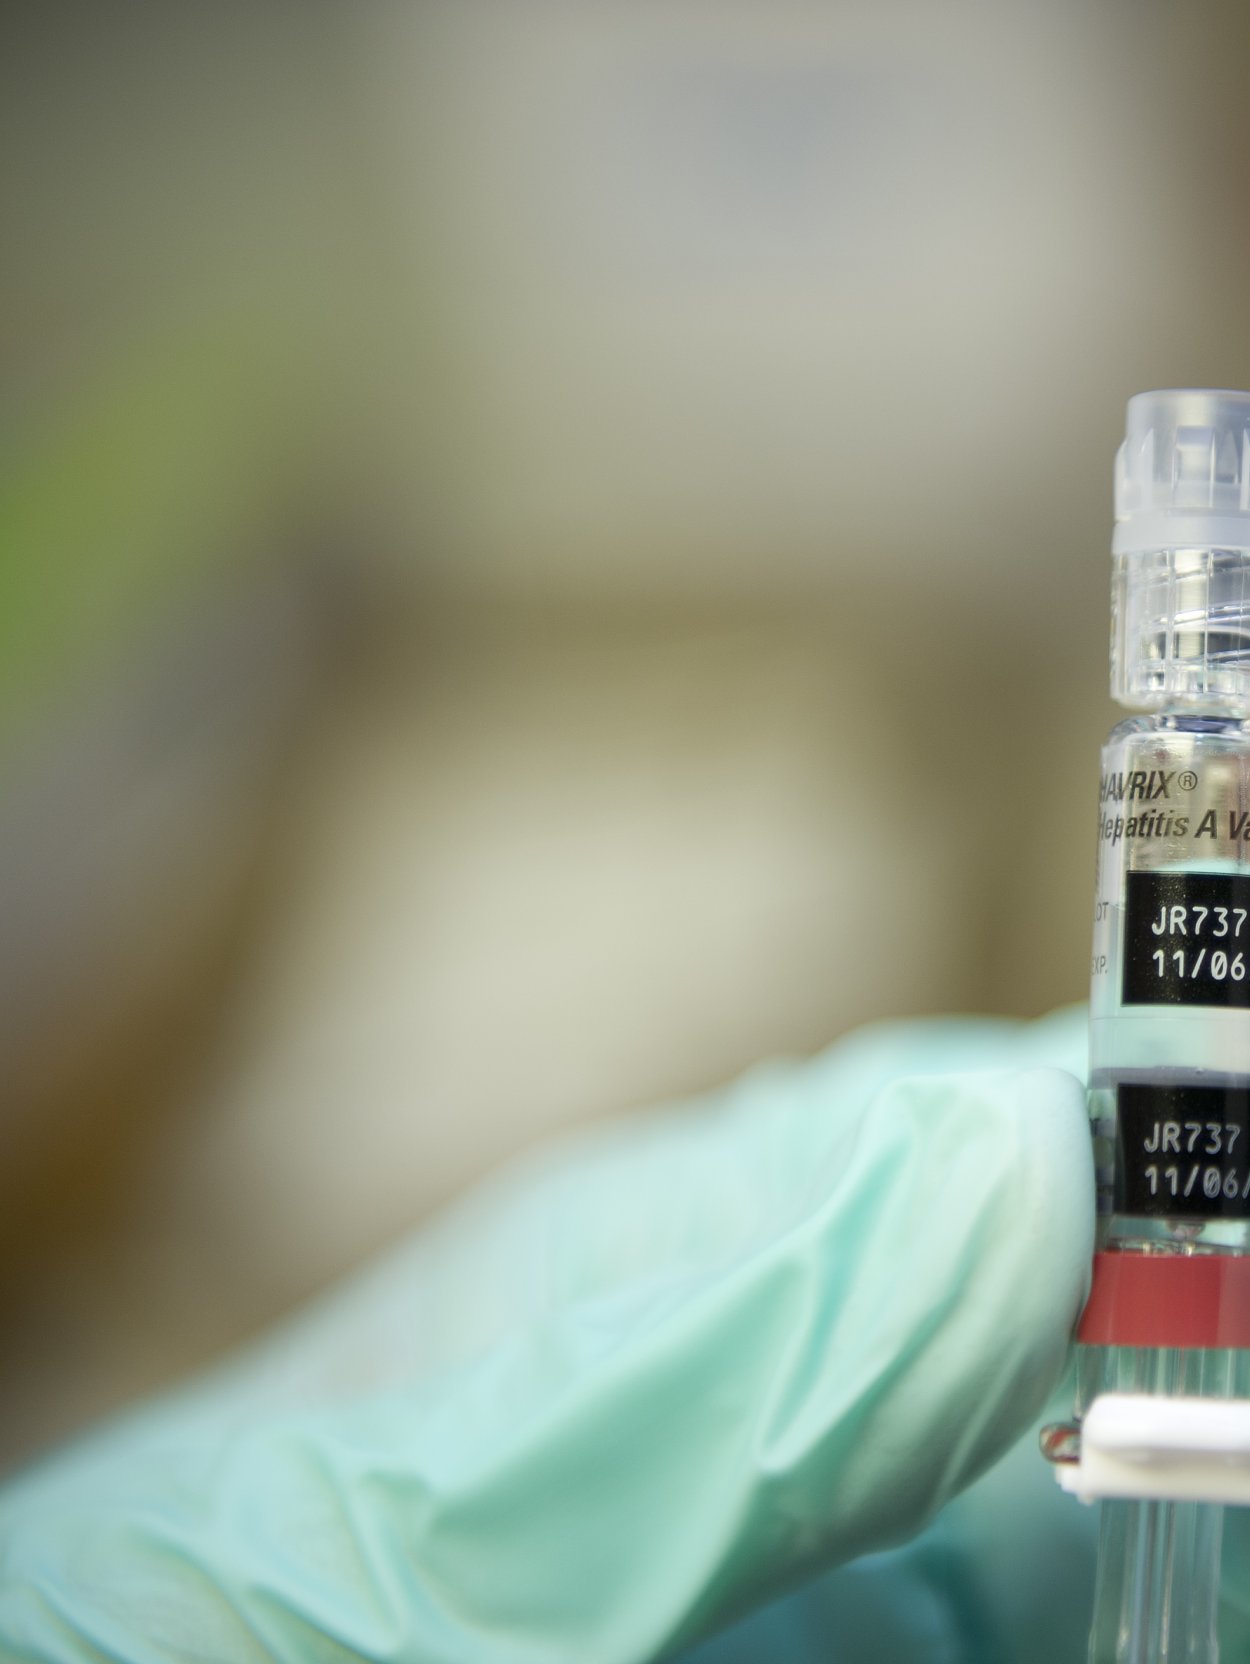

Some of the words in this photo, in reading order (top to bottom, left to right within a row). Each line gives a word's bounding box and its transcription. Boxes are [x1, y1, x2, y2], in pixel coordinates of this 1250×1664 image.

[1194, 809, 1218, 839] A
[1151, 906, 1248, 938] JR737
[1144, 1121, 1241, 1154] JR737
